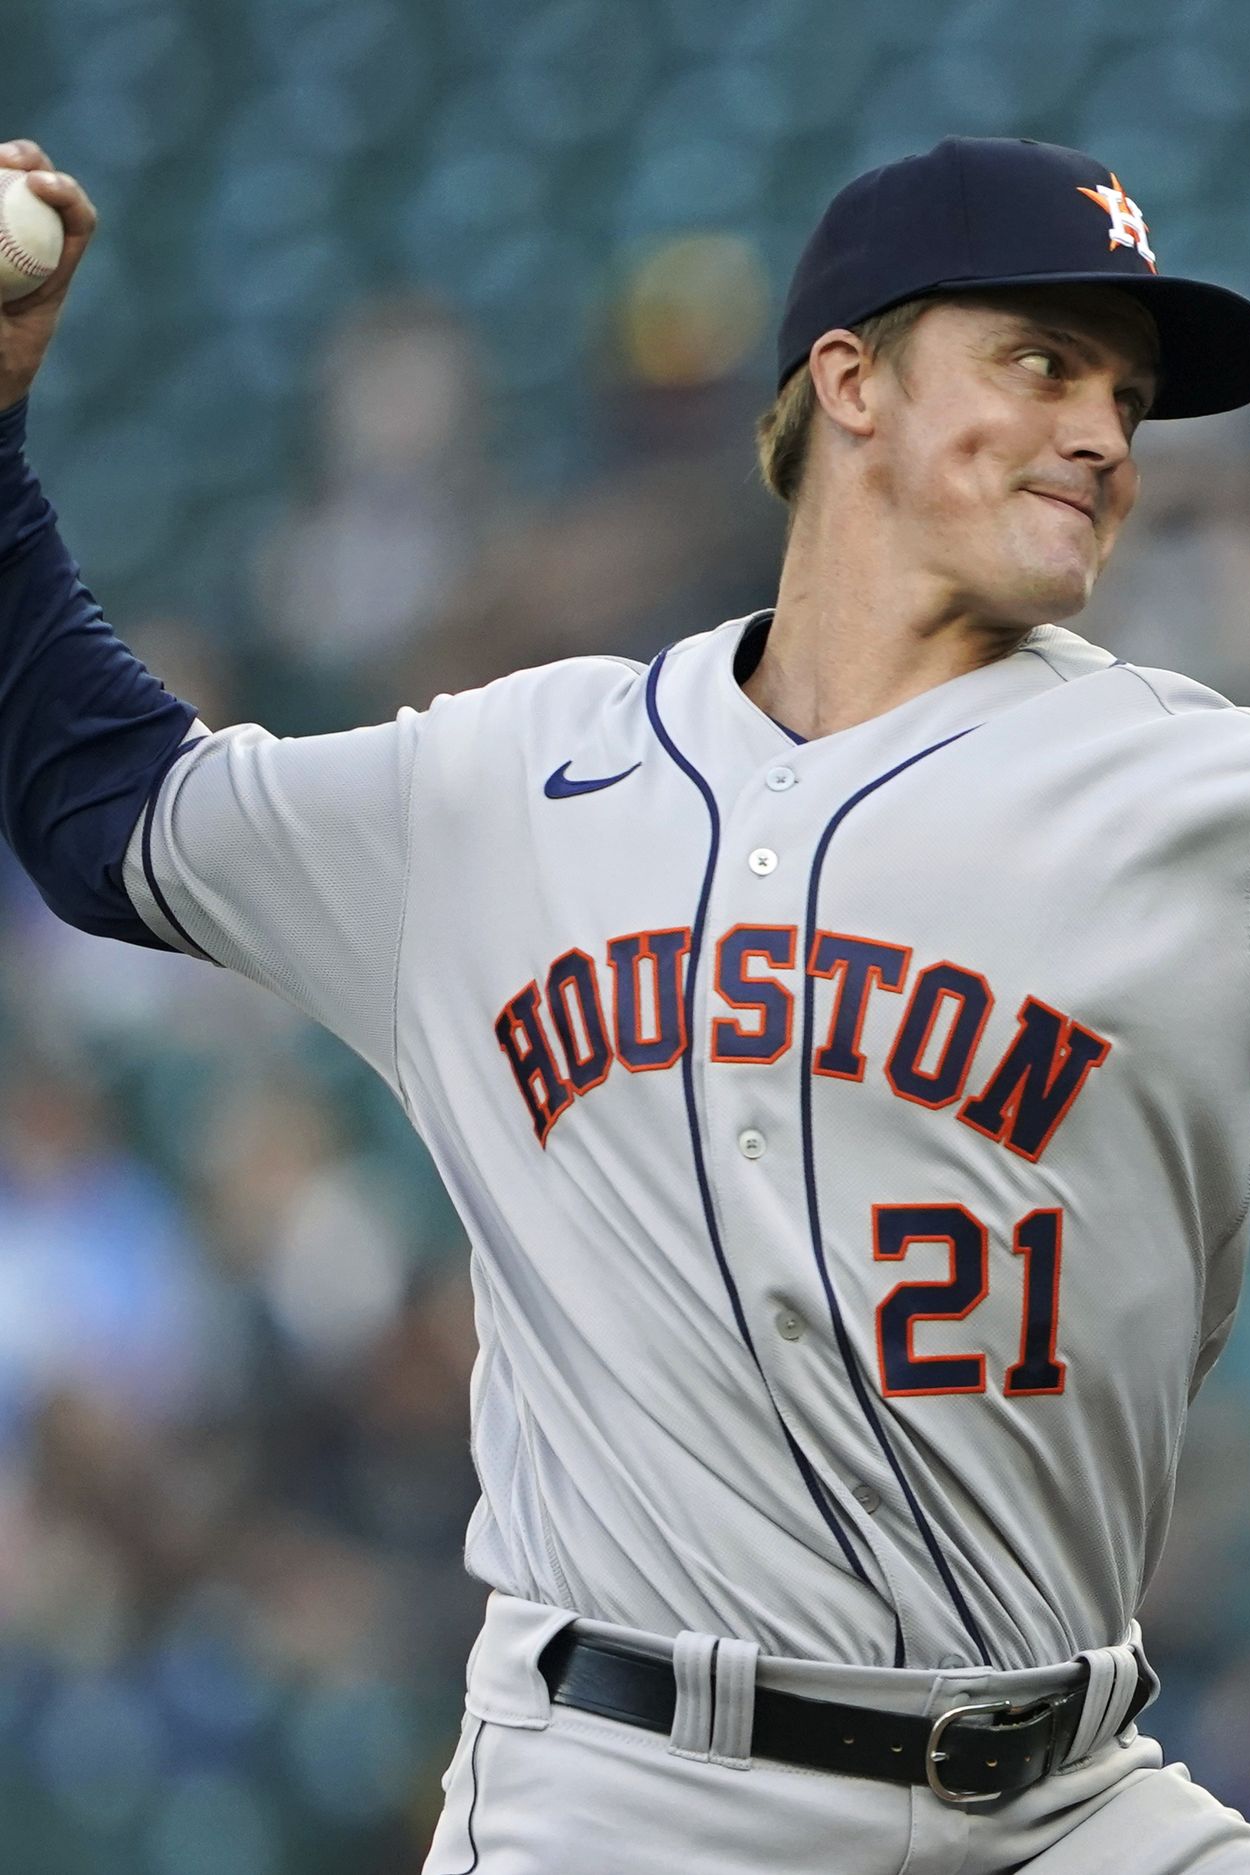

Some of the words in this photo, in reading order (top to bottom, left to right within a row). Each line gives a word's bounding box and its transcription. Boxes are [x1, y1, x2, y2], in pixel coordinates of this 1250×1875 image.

[1095, 184, 1156, 262] H
[494, 924, 1112, 1163] HOUSTON
[871, 1203, 1066, 1397] 21
